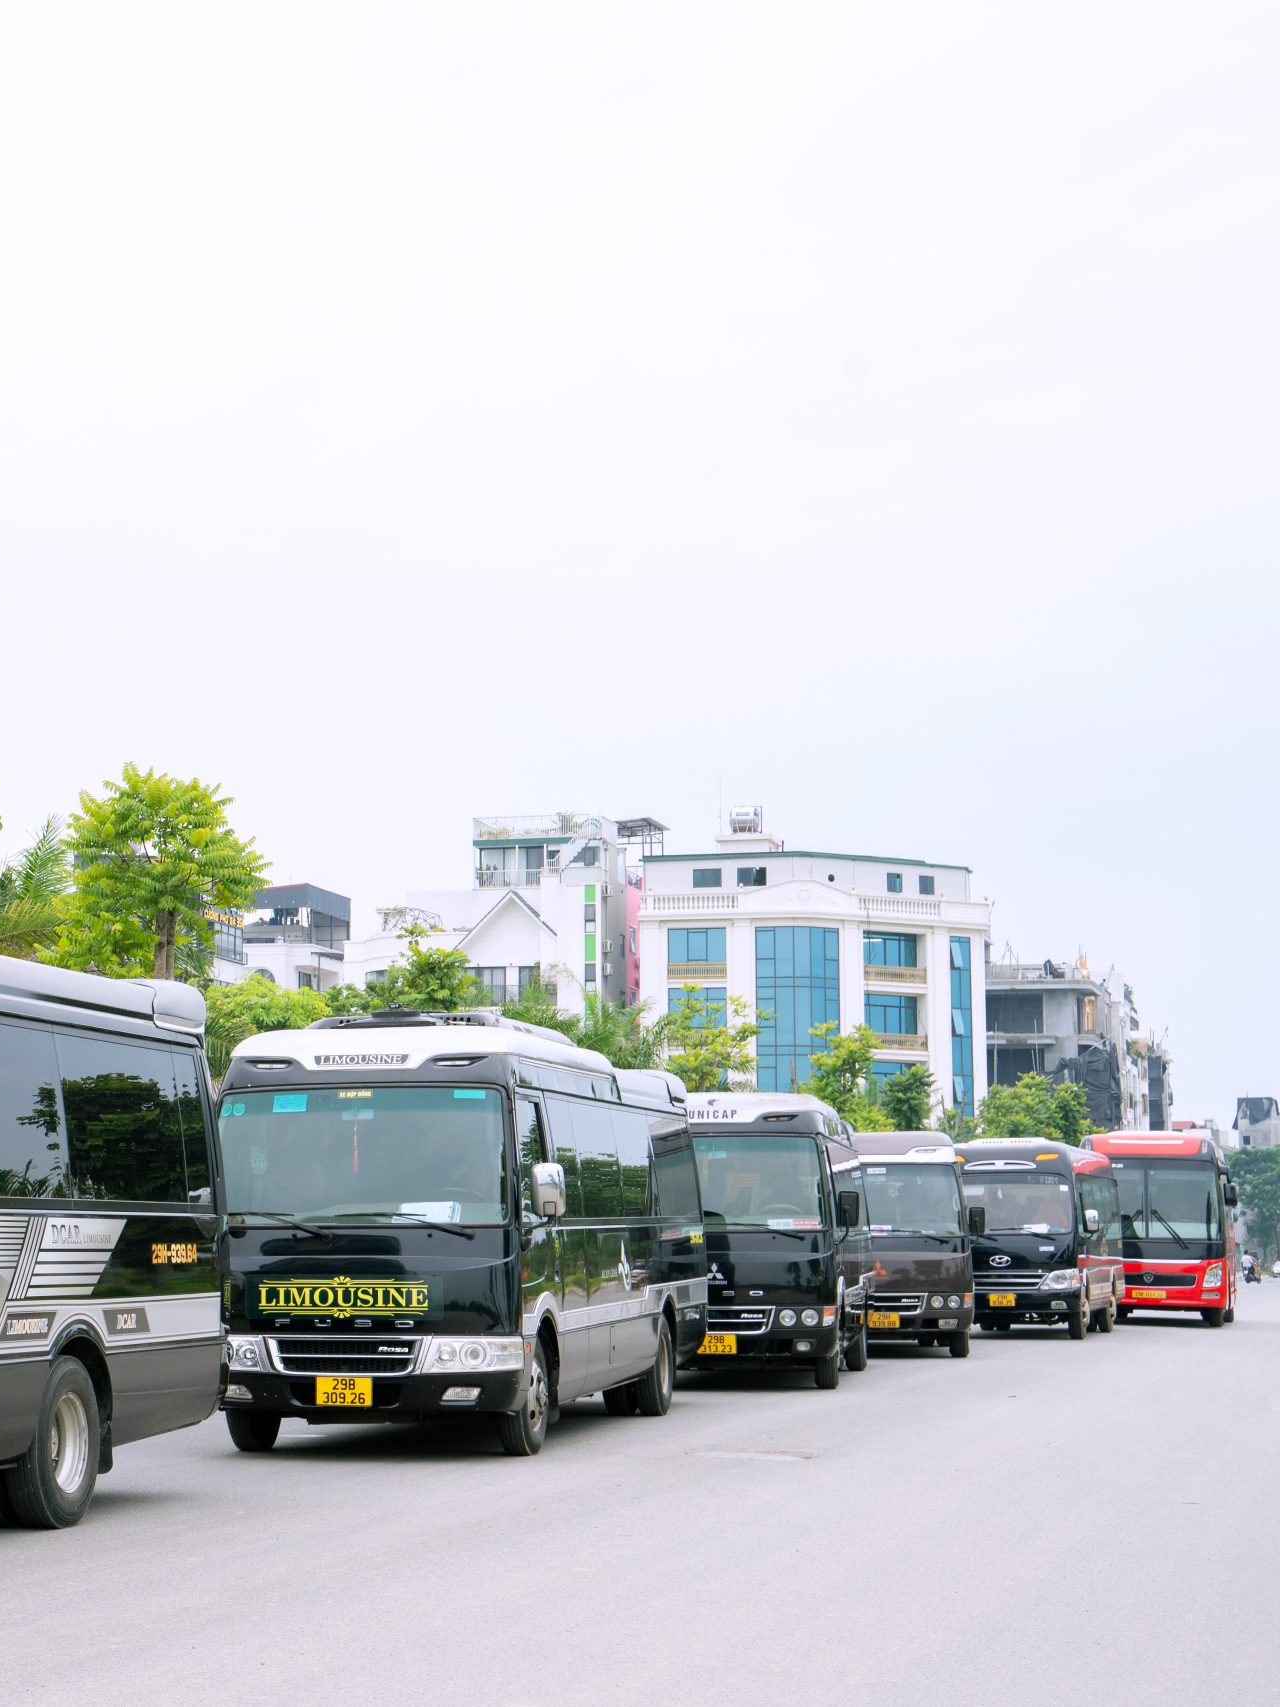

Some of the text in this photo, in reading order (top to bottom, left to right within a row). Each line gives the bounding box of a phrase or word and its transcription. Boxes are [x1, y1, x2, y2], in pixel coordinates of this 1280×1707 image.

[320, 1054, 402, 1065] LIMOUSINE
[689, 1109, 737, 1120] UNICAP
[51, 1224, 112, 1245] DCAR LIMOUSINE
[151, 1242, 198, 1265] 29H-939.64
[259, 1287, 428, 1308] LIMOUSINE
[6, 1317, 48, 1336] LIMOUSINE
[116, 1313, 136, 1330] DCAR
[275, 1318, 414, 1328] FUSO
[708, 1335, 725, 1344] 29B
[701, 1344, 732, 1353] 313.23
[332, 1378, 356, 1391] 29B
[323, 1392, 366, 1405] 309.26
